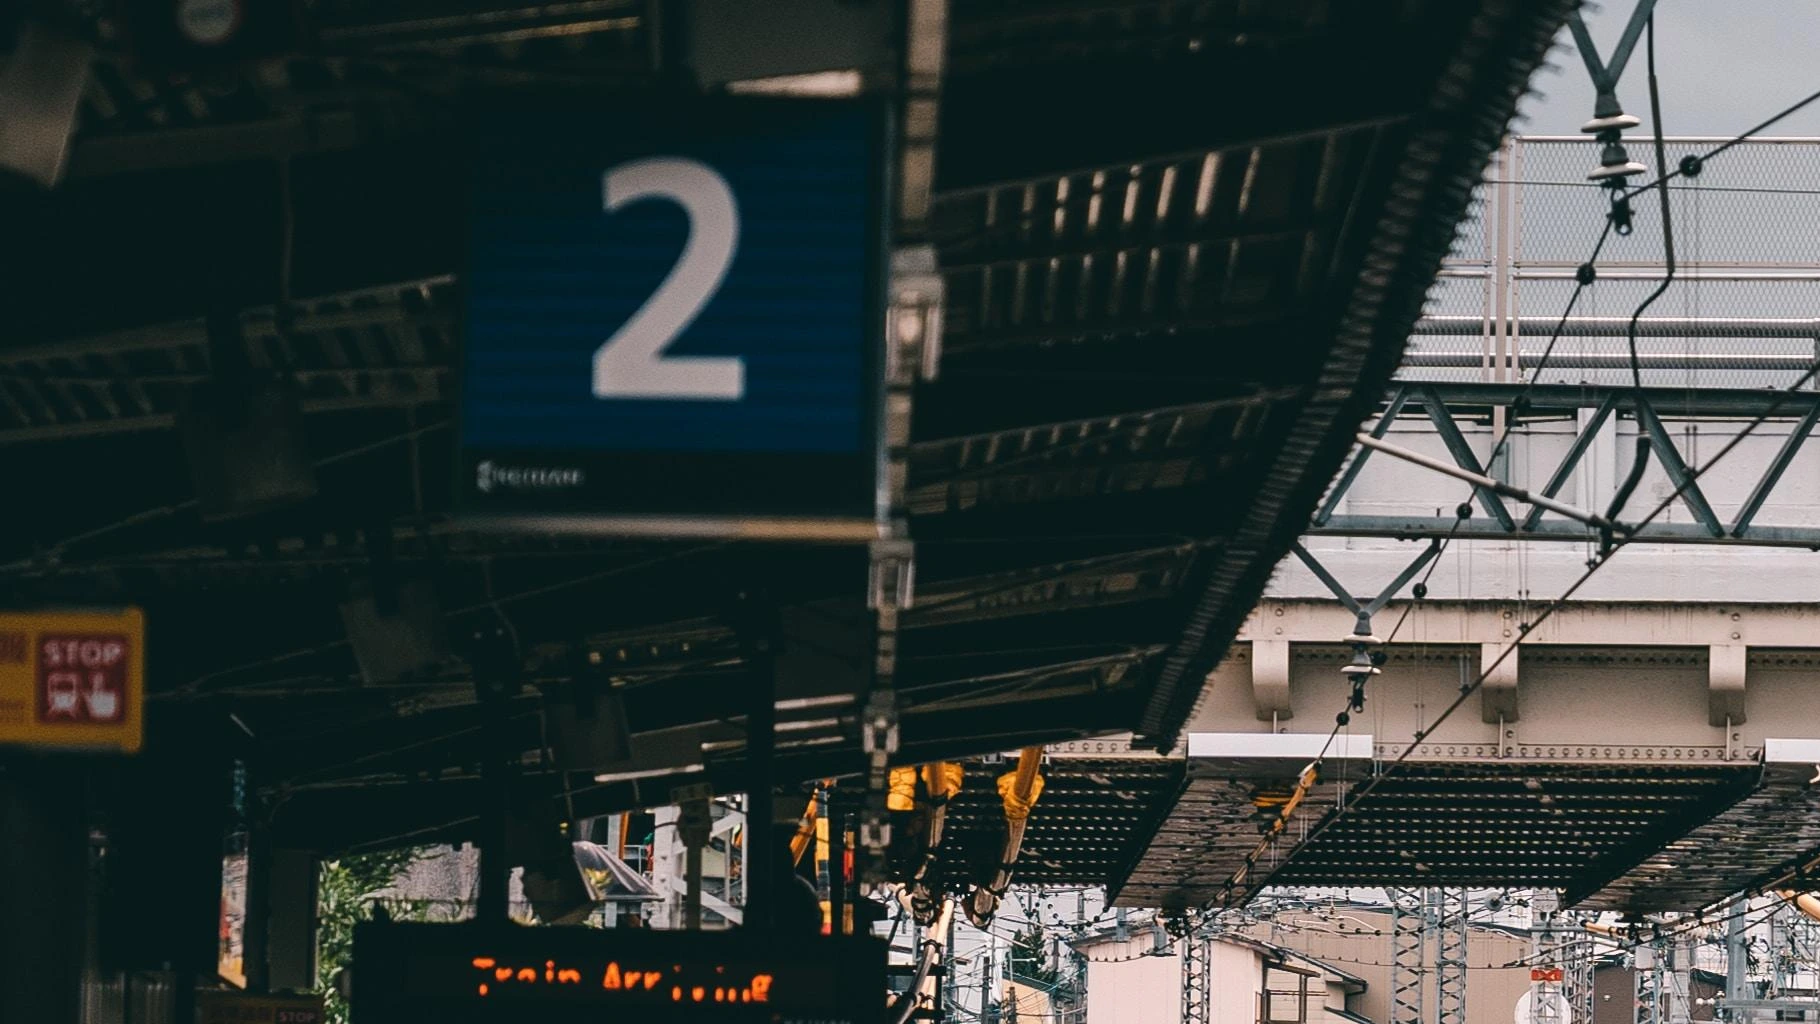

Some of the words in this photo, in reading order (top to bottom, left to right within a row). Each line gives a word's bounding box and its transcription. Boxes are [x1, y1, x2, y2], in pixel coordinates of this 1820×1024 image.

[592, 157, 746, 401] 2
[44, 640, 121, 668] STOP
[279, 1011, 315, 1023] STOP
